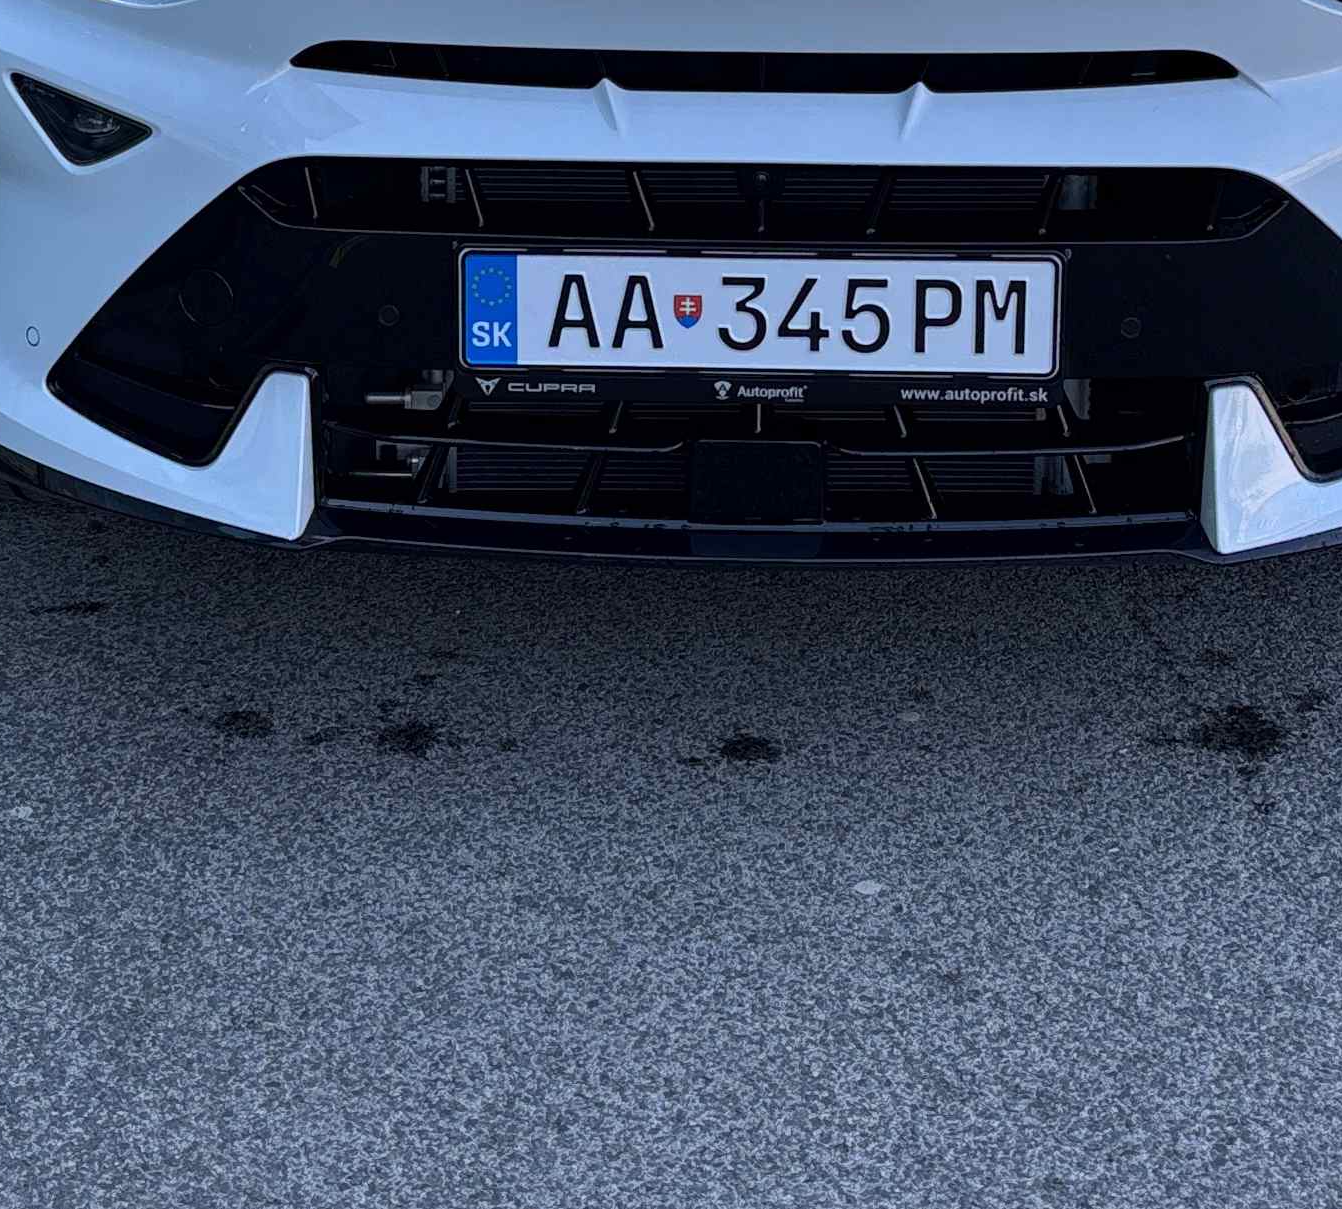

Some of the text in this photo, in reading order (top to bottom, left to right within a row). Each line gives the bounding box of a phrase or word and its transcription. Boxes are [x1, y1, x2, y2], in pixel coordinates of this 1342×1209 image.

[547, 274, 665, 350] AA
[471, 320, 512, 349] SK
[508, 382, 596, 393] CUPRA
[737, 384, 805, 401] Autoprofit
[900, 387, 1048, 404] www.autoprofit.sk
